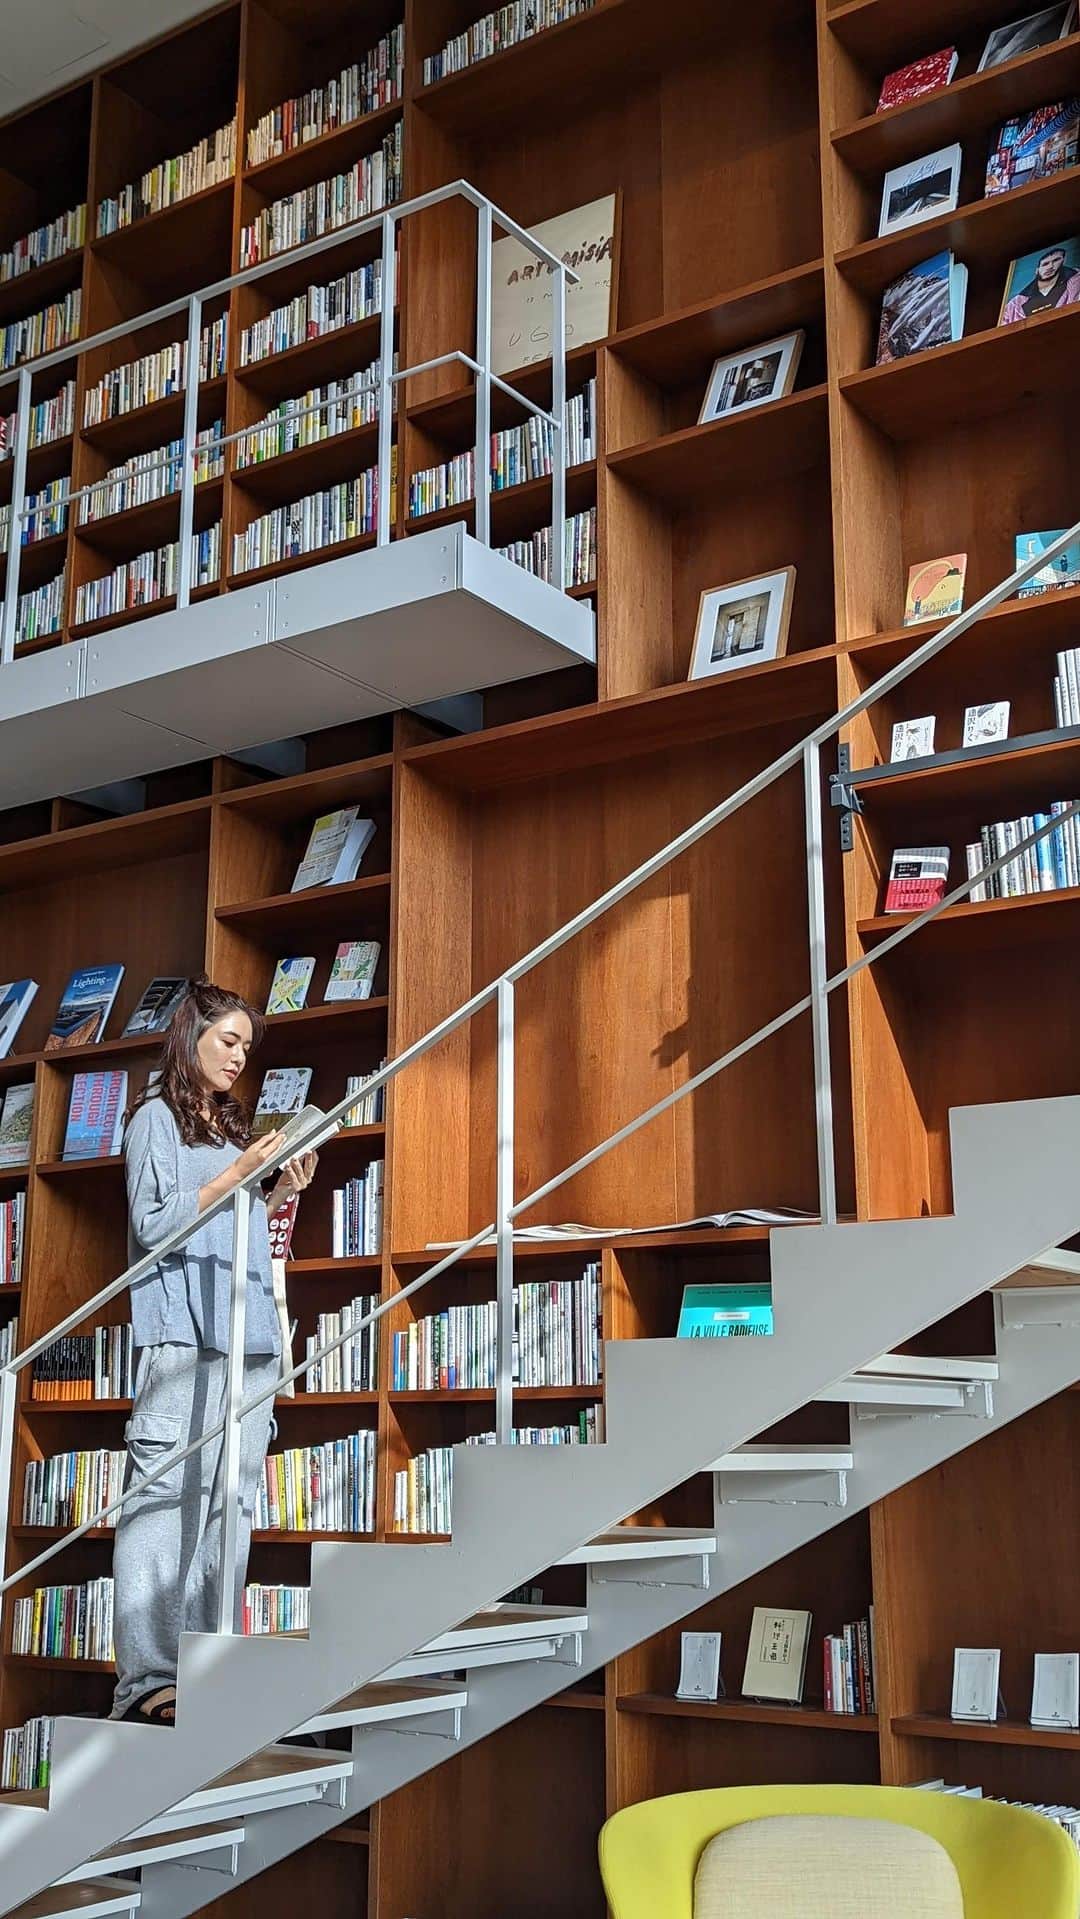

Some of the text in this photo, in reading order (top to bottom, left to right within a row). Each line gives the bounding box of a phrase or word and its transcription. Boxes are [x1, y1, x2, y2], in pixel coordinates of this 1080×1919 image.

[72, 976, 106, 989] Lighting
[70, 1073, 88, 1123] SECTION
[87, 1072, 105, 1128] THROUGH
